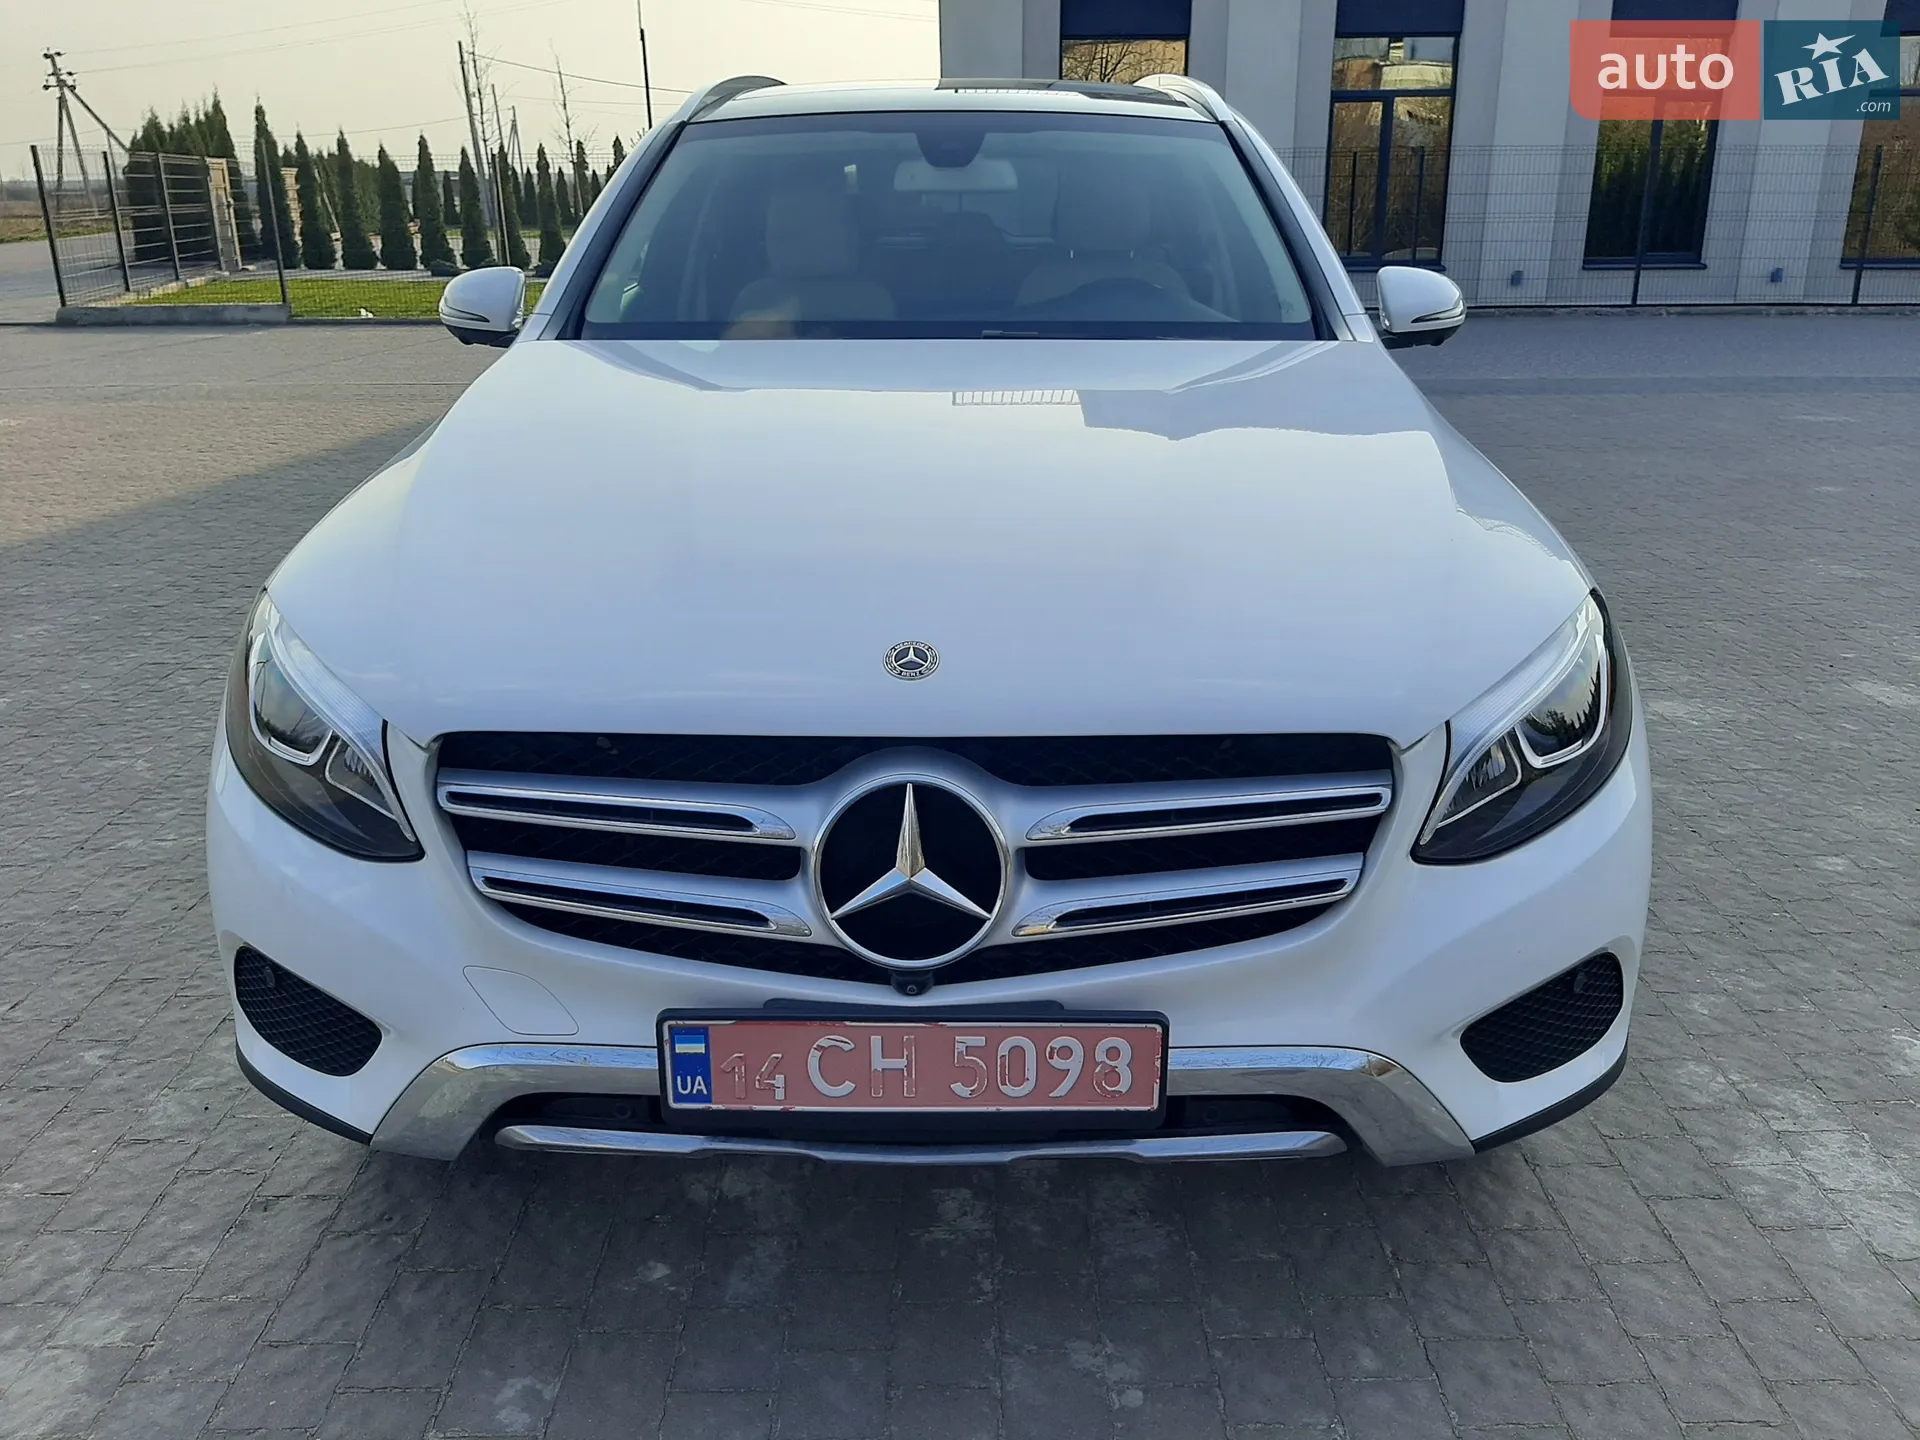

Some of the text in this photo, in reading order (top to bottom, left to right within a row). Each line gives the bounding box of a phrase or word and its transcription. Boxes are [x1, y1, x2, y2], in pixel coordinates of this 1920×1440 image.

[676, 1075, 708, 1096] UA
[720, 1034, 1133, 1100] 14 CH 5098
